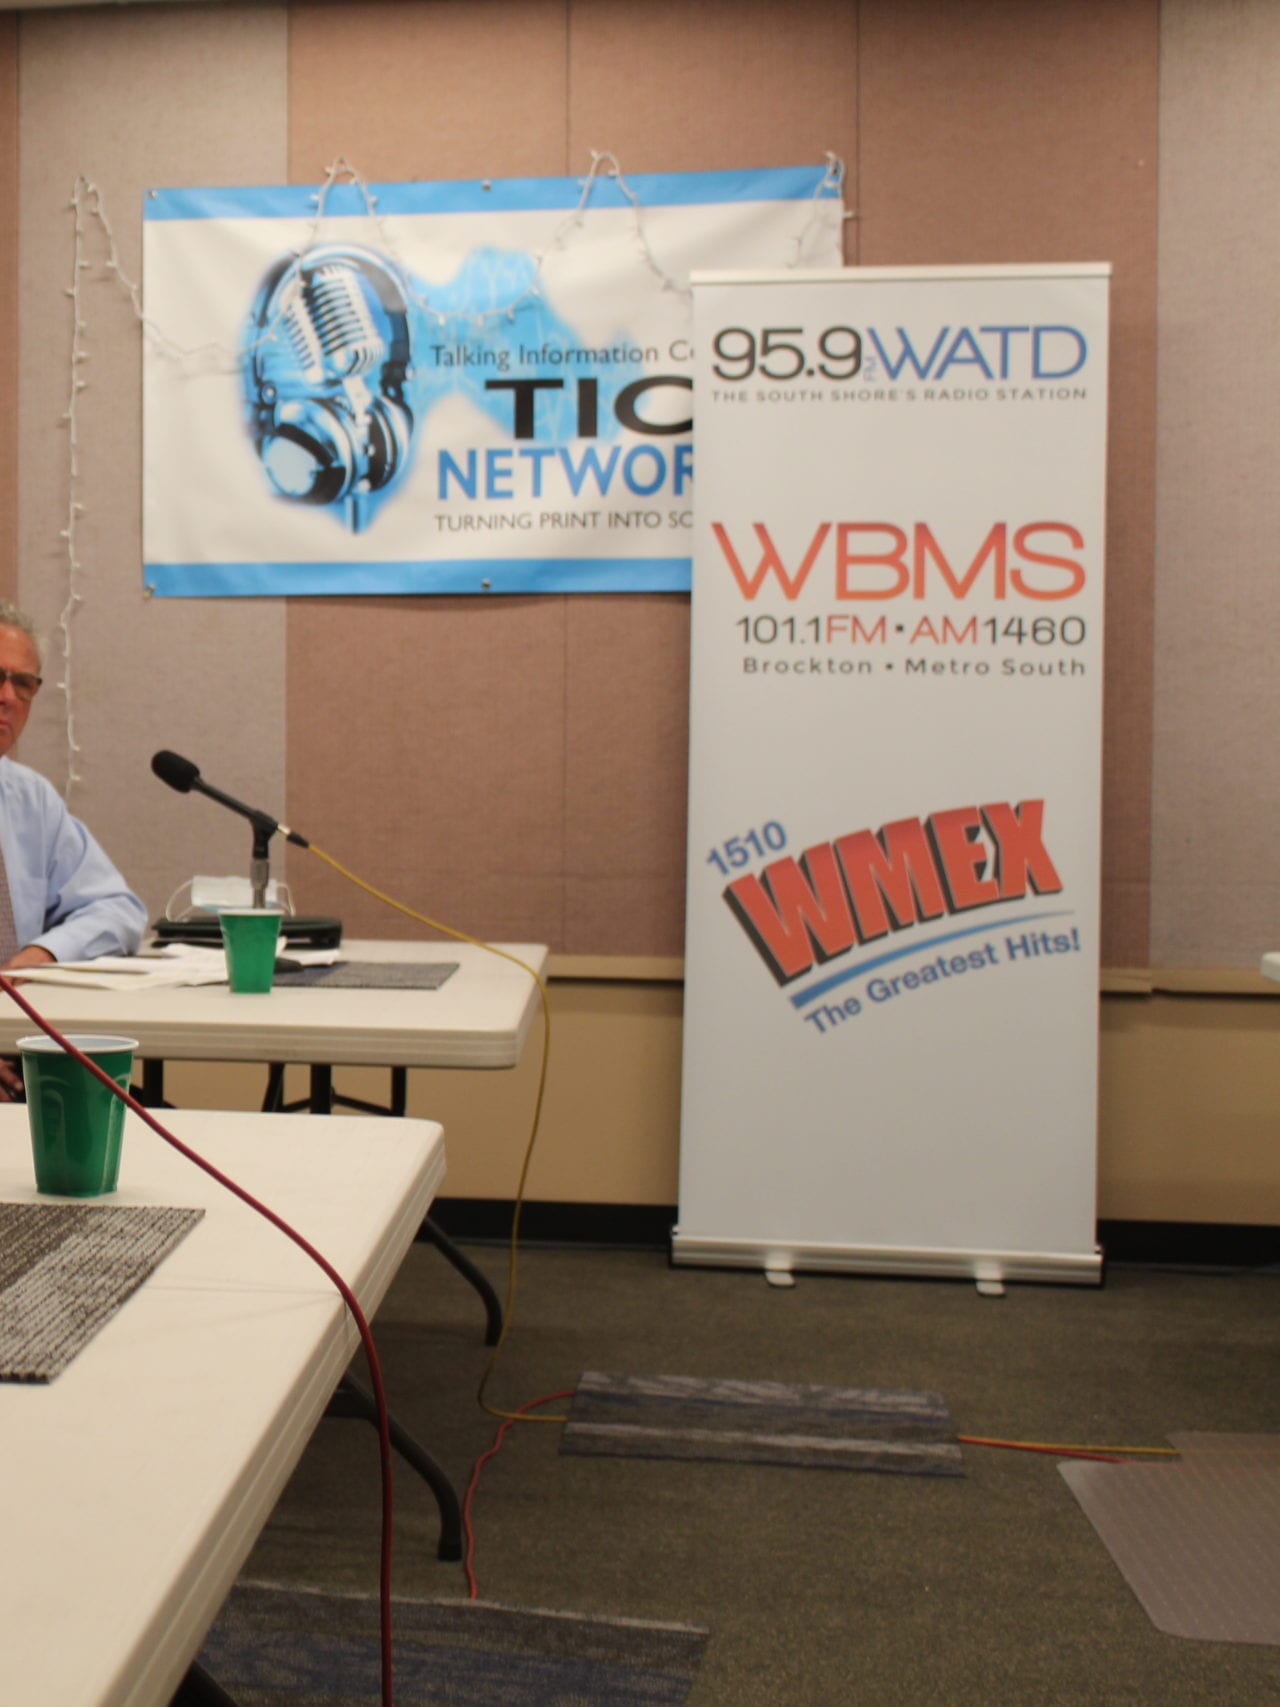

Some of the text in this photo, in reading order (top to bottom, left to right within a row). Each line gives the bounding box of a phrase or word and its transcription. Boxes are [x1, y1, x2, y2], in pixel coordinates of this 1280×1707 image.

[431, 344, 510, 371] Talking
[519, 341, 658, 365] Information
[712, 325, 862, 381] 95.9
[867, 324, 1088, 380] WATD
[484, 375, 694, 439] TIC
[712, 387, 1087, 402] THE SOUTH SHORE'S RADIO STATION
[434, 513, 532, 532] TURNING
[539, 511, 601, 529] PRINT
[608, 510, 661, 529] INTO
[711, 521, 1087, 601] WBMS
[743, 656, 1085, 677] Brockton Metro South
[707, 821, 788, 876] 1510
[722, 799, 1063, 988] WMEX
[804, 928, 1082, 1034] The Greatest Hits!
